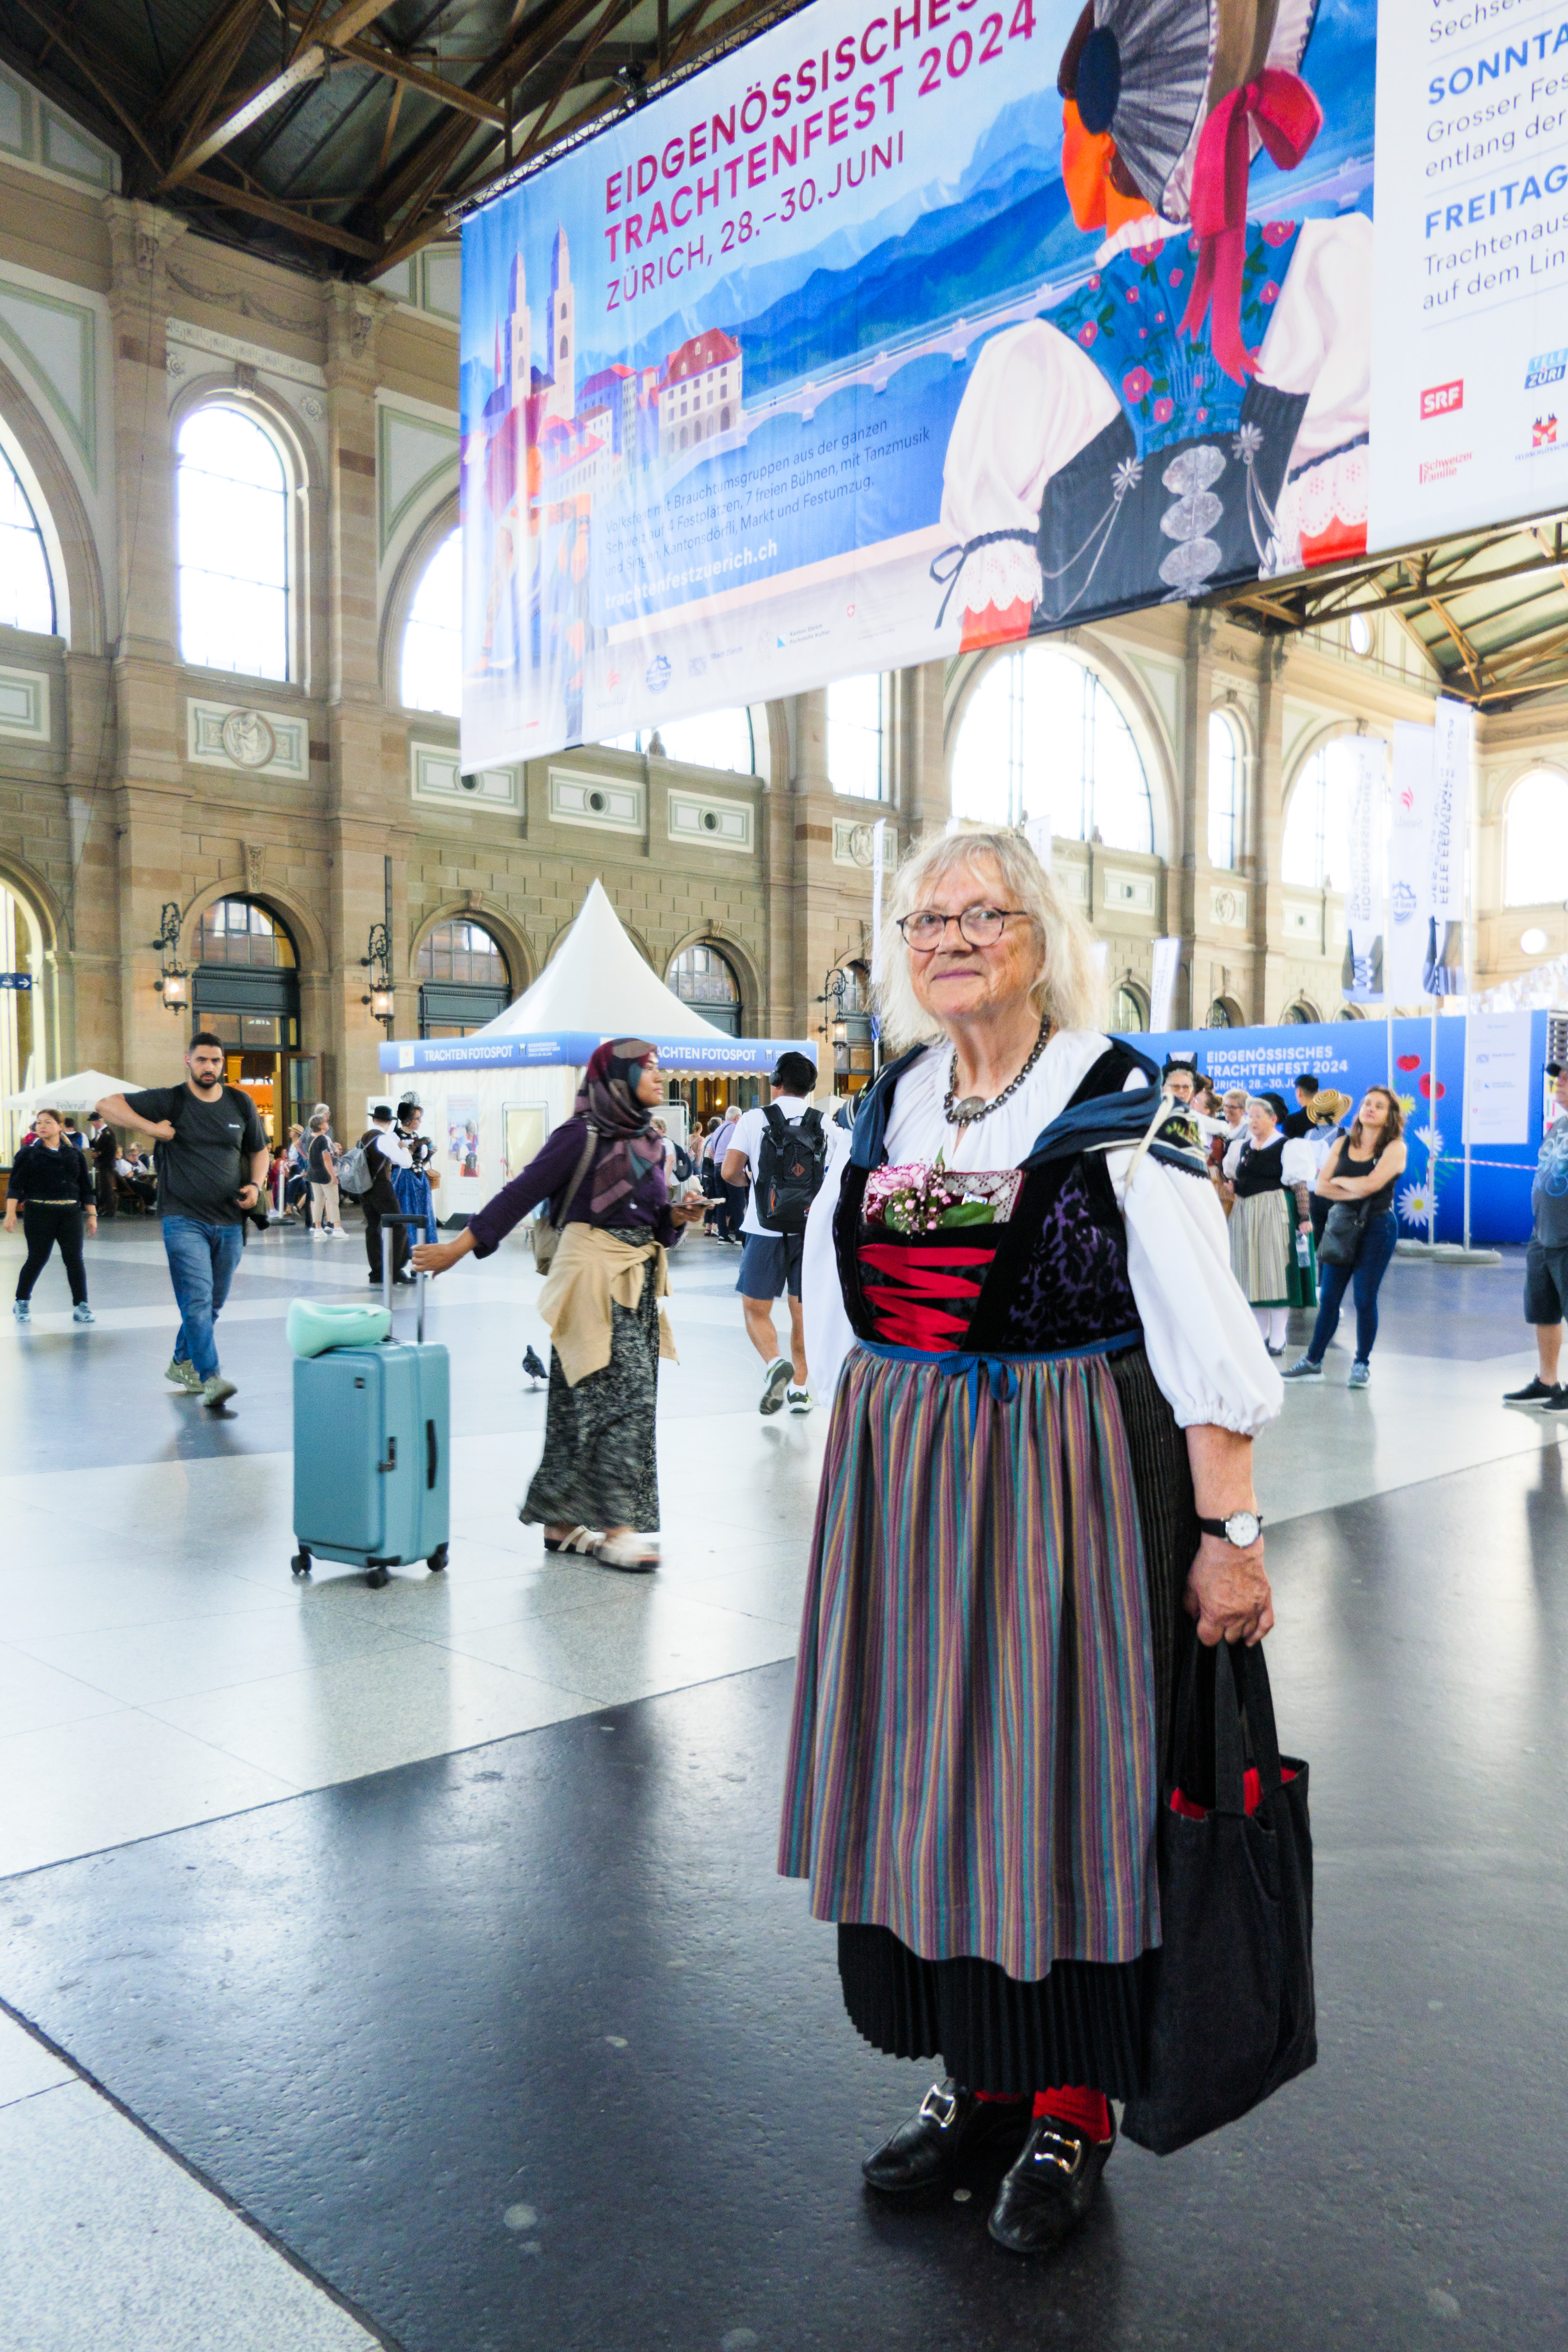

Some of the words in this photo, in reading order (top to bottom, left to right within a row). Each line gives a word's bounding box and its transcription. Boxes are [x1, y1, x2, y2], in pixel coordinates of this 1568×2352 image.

[1430, 0, 1521, 43] Sechse
[1429, 21, 1568, 105] SONNTA
[604, 65, 903, 263] TRACHTENFEST
[918, 0, 1037, 98] 2024
[606, 0, 978, 214] EIDGENÖSSISCHE
[1427, 92, 1522, 143] Grosser
[1426, 131, 1515, 177] entlang
[1525, 109, 1567, 138] der
[1426, 164, 1568, 240] FREITAG
[606, 234, 712, 313] ZÜRICH,
[1423, 279, 1460, 310] auf
[1467, 266, 1519, 295] dem
[1424, 386, 1459, 413] SRF
[1528, 366, 1563, 388] ZÜRI
[605, 507, 651, 534] Volksfest
[654, 499, 671, 516] mit
[674, 456, 790, 509] Brauchtumsgruppen
[793, 448, 814, 465] aus
[817, 439, 838, 456] der
[841, 419, 887, 449] ganzen
[1423, 451, 1474, 471] Schweizer
[605, 534, 646, 556] Schweiz
[649, 525, 665, 540] auf
[668, 519, 675, 533] 4
[678, 500, 743, 531] Festplätzen,
[745, 491, 752, 506] 7
[755, 482, 787, 503] freien
[791, 465, 838, 490] Bühnen,
[840, 452, 861, 472] mit
[864, 426, 930, 463] Tanzmusik
[663, 521, 738, 557] Kantonsdörfli,
[740, 508, 774, 531] Markt
[777, 497, 799, 519] und
[803, 477, 874, 510] Festumzug.
[604, 538, 777, 610] trachtenfestzuerich.ch
[424, 1048, 468, 1062] TRACHTEN
[468, 1045, 513, 1060] FOTOSPOT
[656, 1046, 701, 1060] ACHTEN
[702, 1048, 756, 1061] FOTOSPOT
[1206, 1045, 1333, 1063] EIDGENÖSSISCHES
[1206, 1061, 1309, 1077] TRACHTENFEST
[1313, 1060, 1348, 1074] 2024
[1214, 1079, 1246, 1090] ÜRICH,
